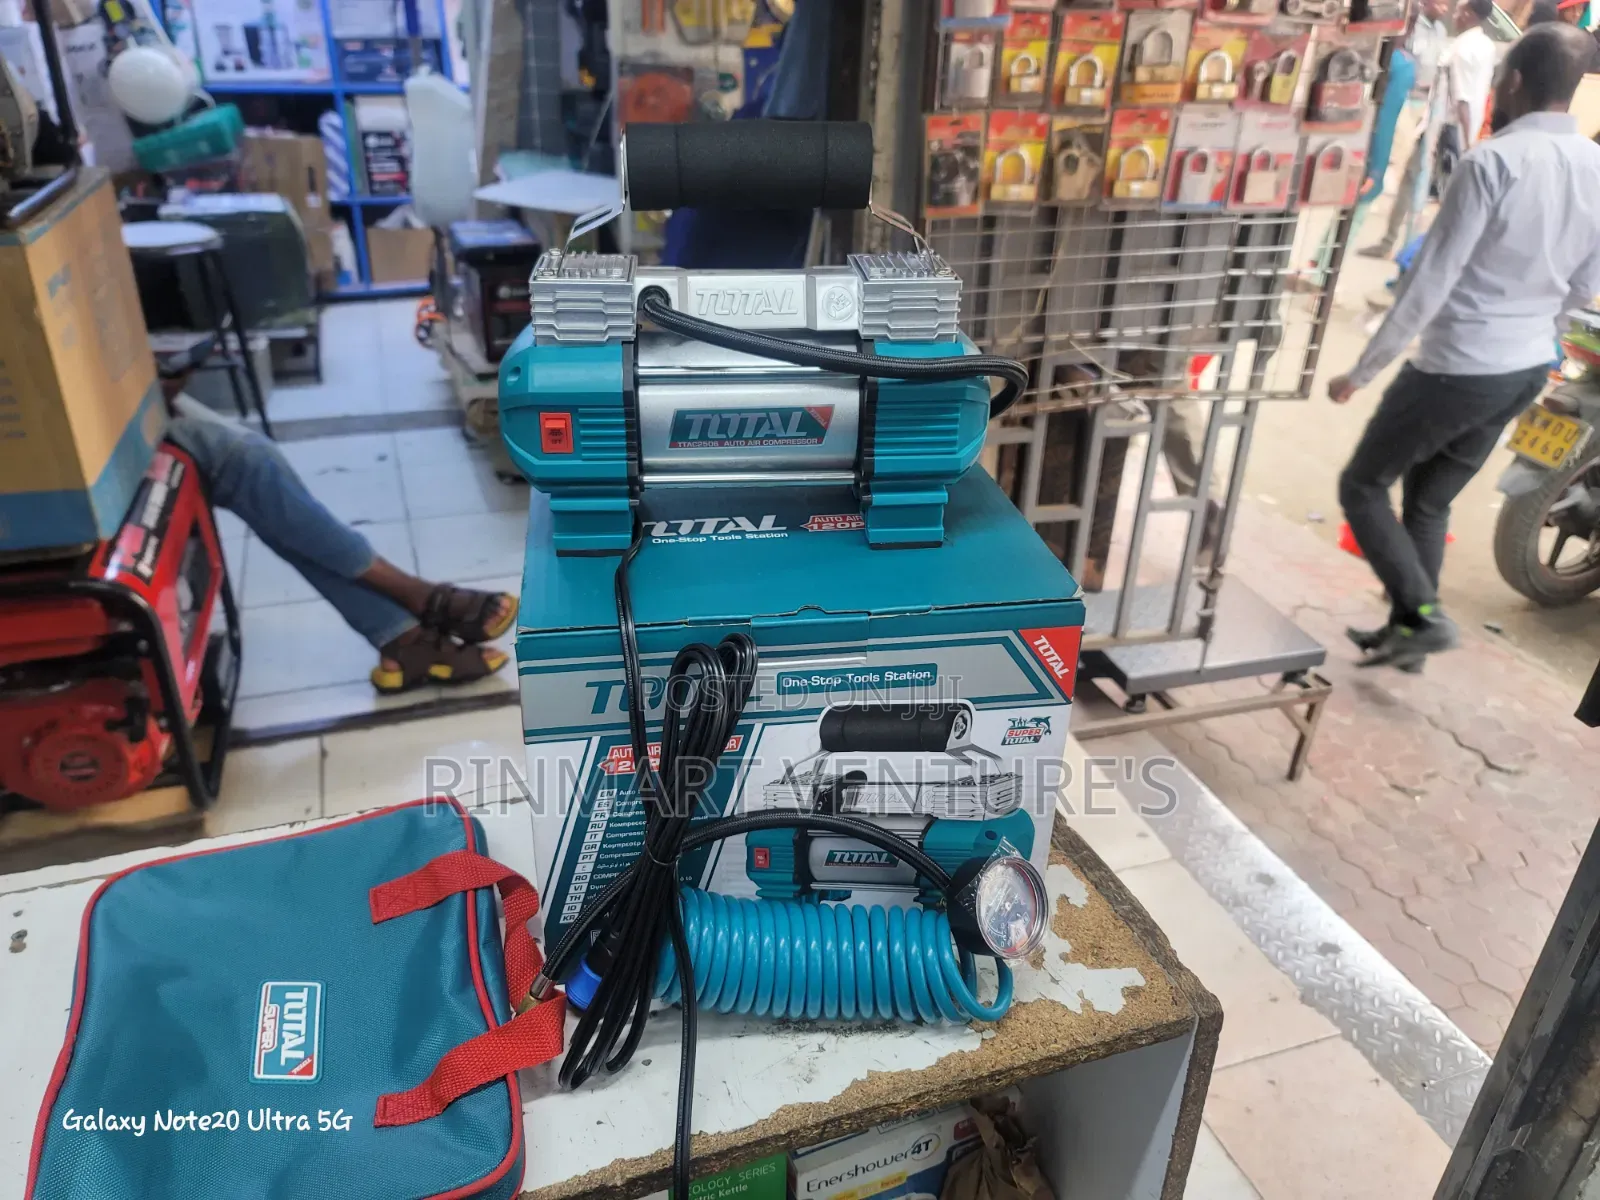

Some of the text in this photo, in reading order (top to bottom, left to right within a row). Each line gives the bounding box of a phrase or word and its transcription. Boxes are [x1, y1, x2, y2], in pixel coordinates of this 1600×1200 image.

[696, 288, 799, 316] TOTAL
[684, 411, 808, 440] TOTAL
[723, 439, 746, 447] AUTO
[747, 439, 761, 447] AIR
[762, 437, 818, 446] COMPRESSOR
[652, 532, 789, 544] One-Stop Tools Station
[1033, 635, 1070, 680] TOTAL
[782, 669, 932, 688] One-Stop Tools Station
[1007, 728, 1041, 737] SUPER
[1004, 736, 1036, 745] TOTAL
[612, 747, 634, 759] AUT
[600, 790, 614, 798] EN
[590, 822, 604, 830] RU
[584, 843, 597, 851] GR
[833, 851, 890, 864] TOTAL
[569, 894, 582, 902] TH
[567, 904, 577, 912] ID
[562, 914, 576, 922] KR
[260, 1005, 277, 1050] SUPER
[281, 987, 309, 1066] TOTAL
[806, 1148, 908, 1193] Enershower
[911, 1138, 933, 1156] 4T
[689, 1161, 776, 1195] OLOGY SERIES
[718, 1183, 748, 1198] Kettle
